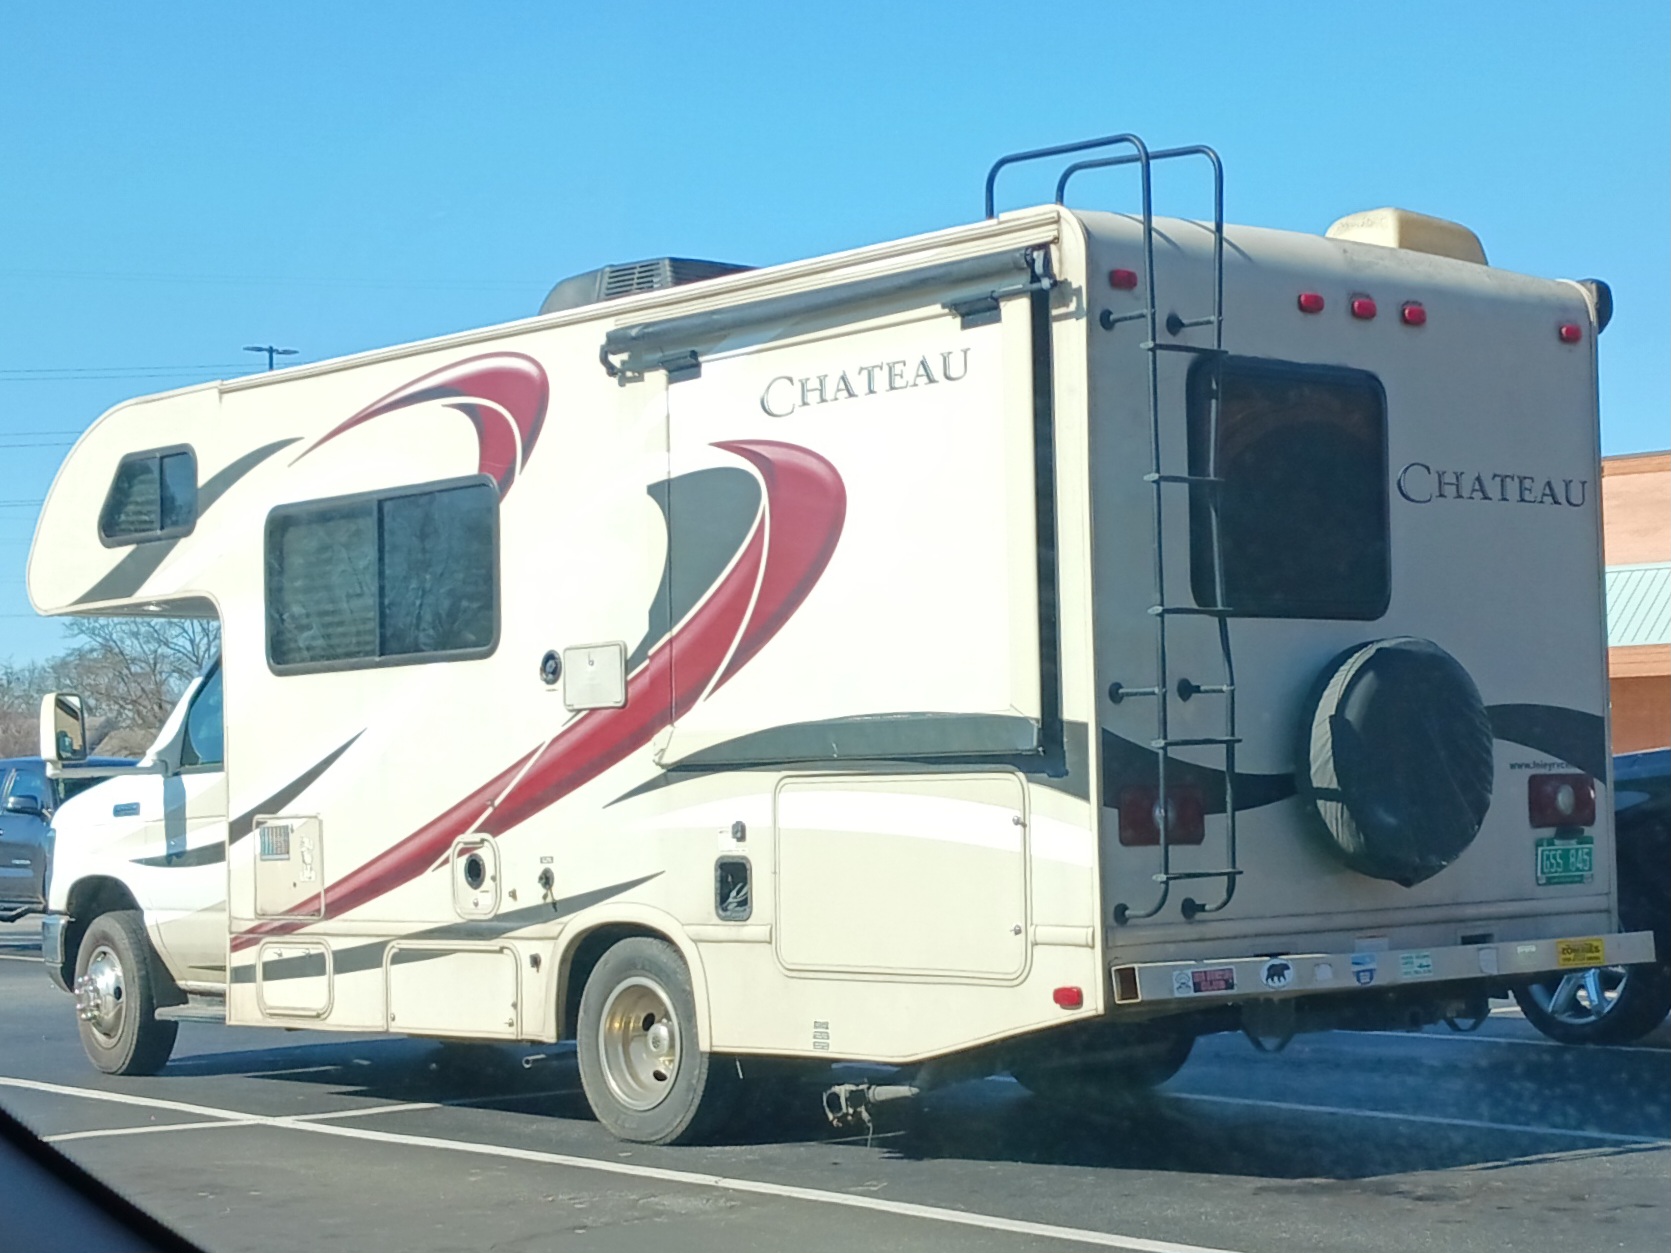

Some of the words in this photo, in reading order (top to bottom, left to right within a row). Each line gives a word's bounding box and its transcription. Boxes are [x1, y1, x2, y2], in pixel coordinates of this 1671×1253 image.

[760, 348, 971, 418] CHATEAU
[1397, 462, 1587, 507] CHATEAU
[1569, 848, 1590, 871] 845
